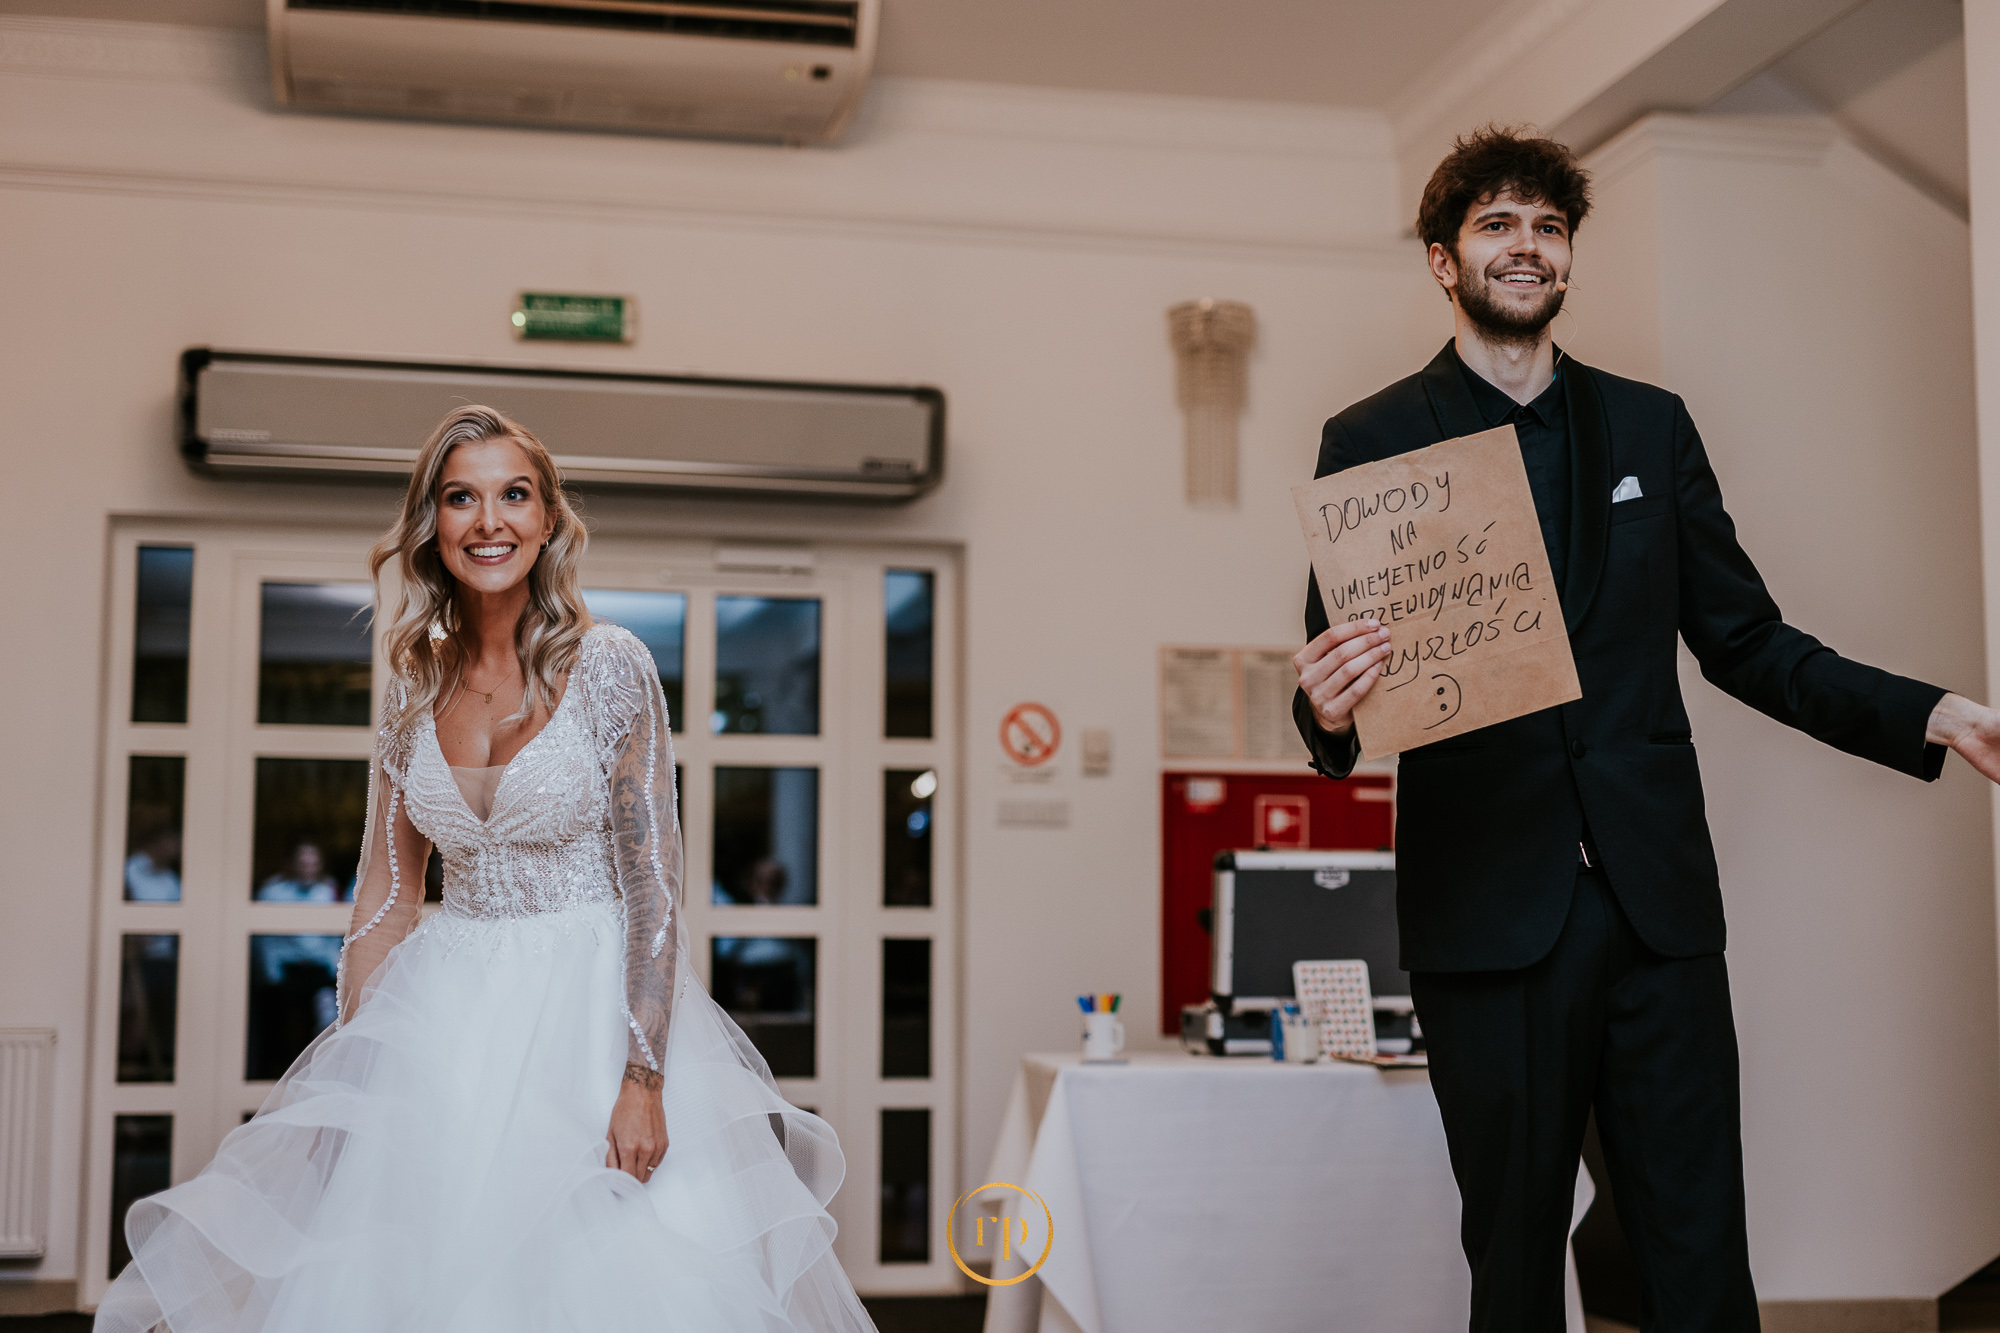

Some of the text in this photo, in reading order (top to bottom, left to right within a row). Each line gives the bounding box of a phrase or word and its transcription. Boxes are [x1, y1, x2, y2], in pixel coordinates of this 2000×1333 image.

[1318, 471, 1451, 543] DOWODY
[1390, 520, 1418, 556] NA
[1379, 597, 1547, 692] ZYSZŁOŚCI
